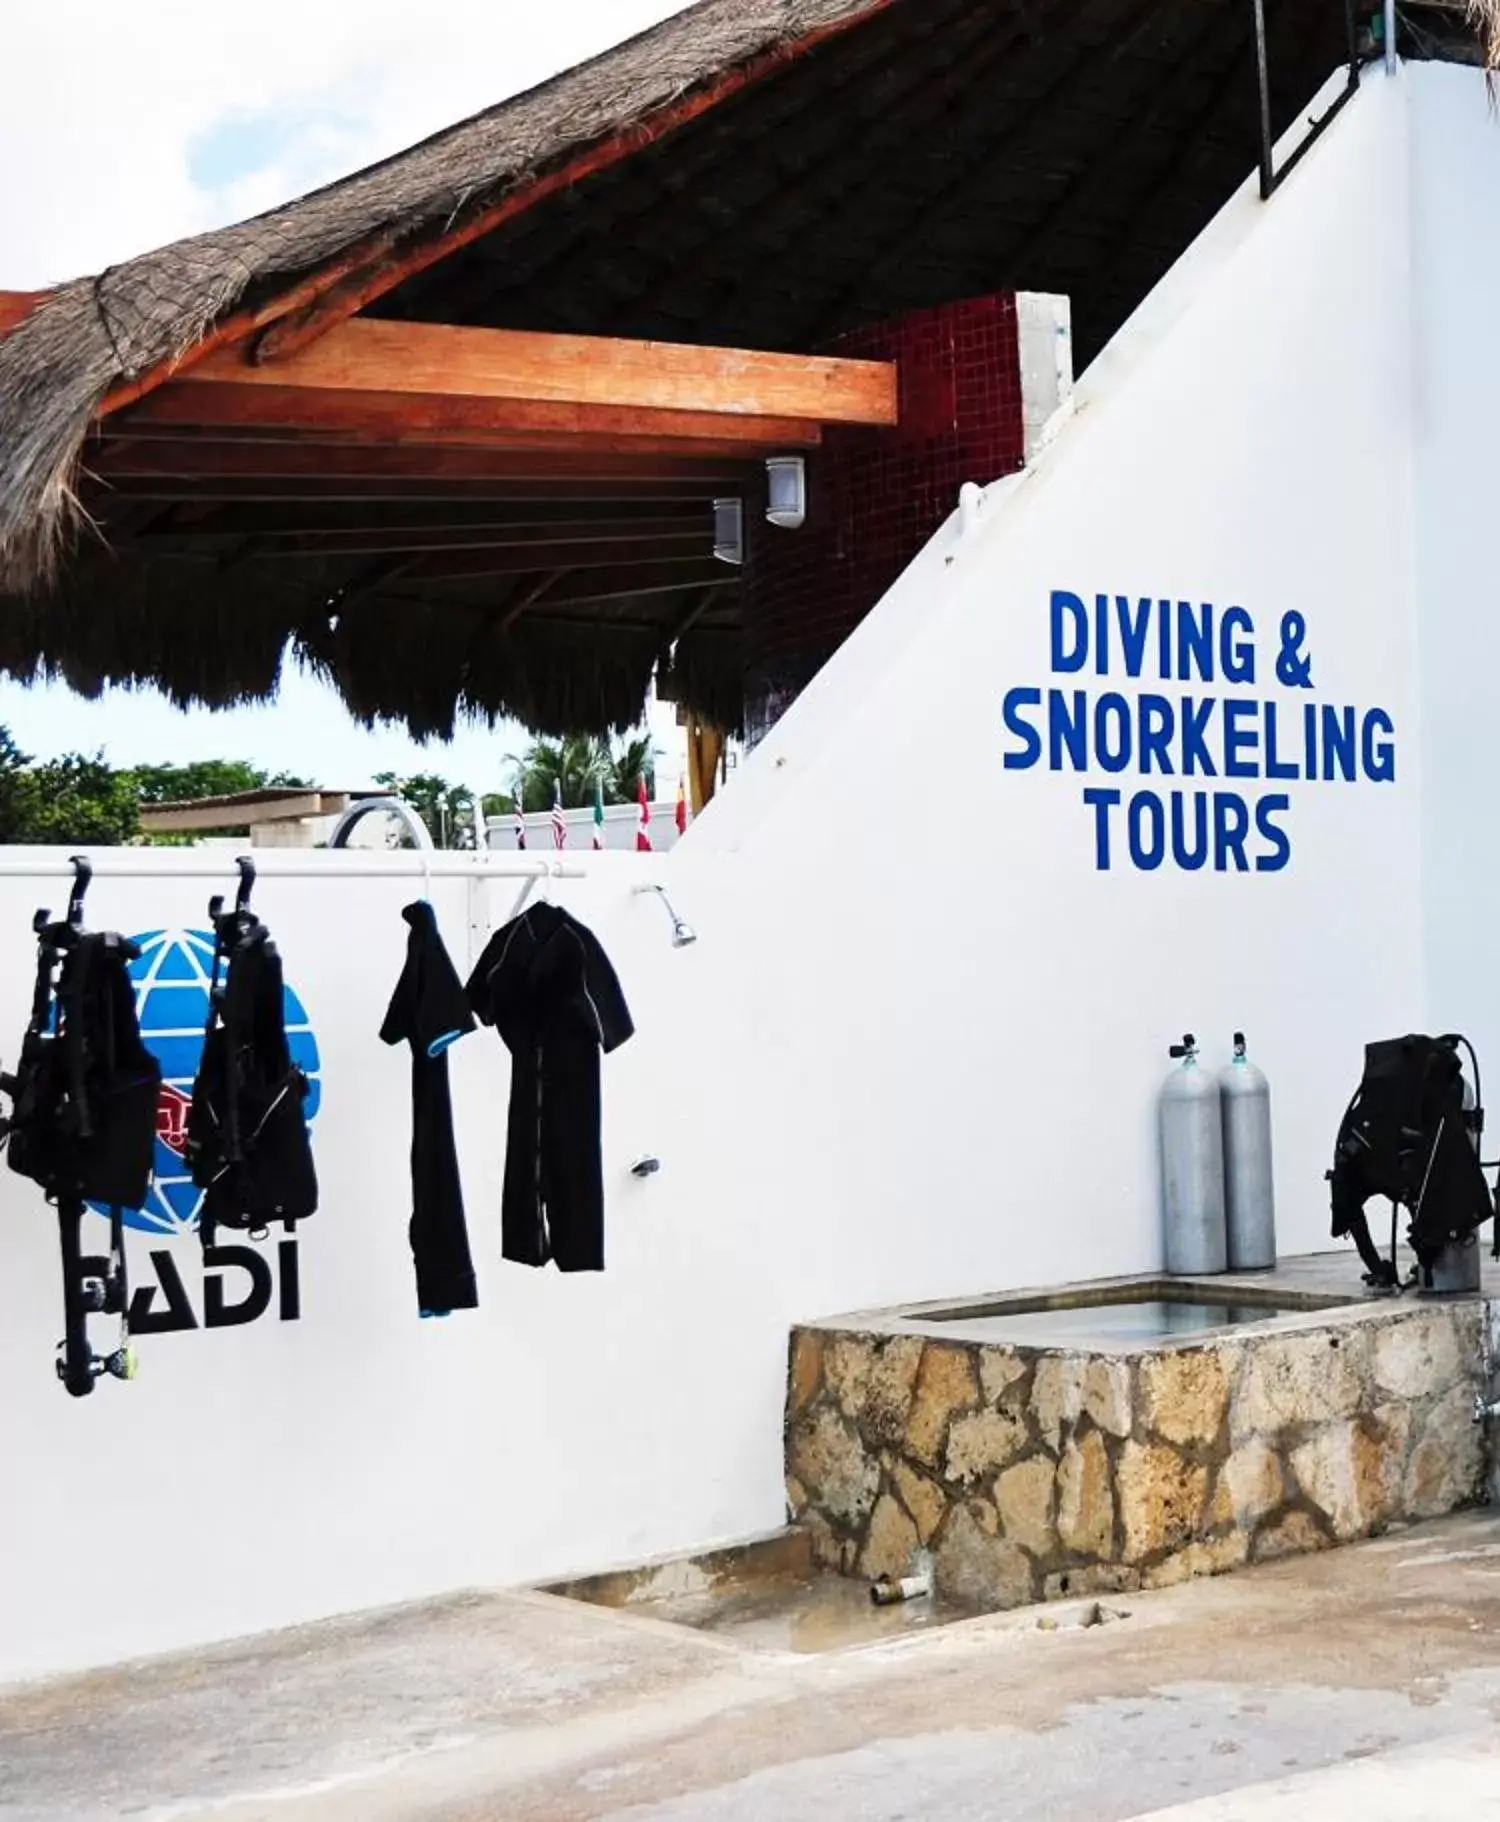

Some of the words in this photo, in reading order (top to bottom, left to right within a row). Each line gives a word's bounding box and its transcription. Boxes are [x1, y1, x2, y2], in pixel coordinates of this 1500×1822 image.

[1050, 590, 1256, 684] DIVING
[1276, 610, 1315, 689] &
[1002, 686, 1396, 783] SNORKELING
[1083, 787, 1291, 873] TOURS
